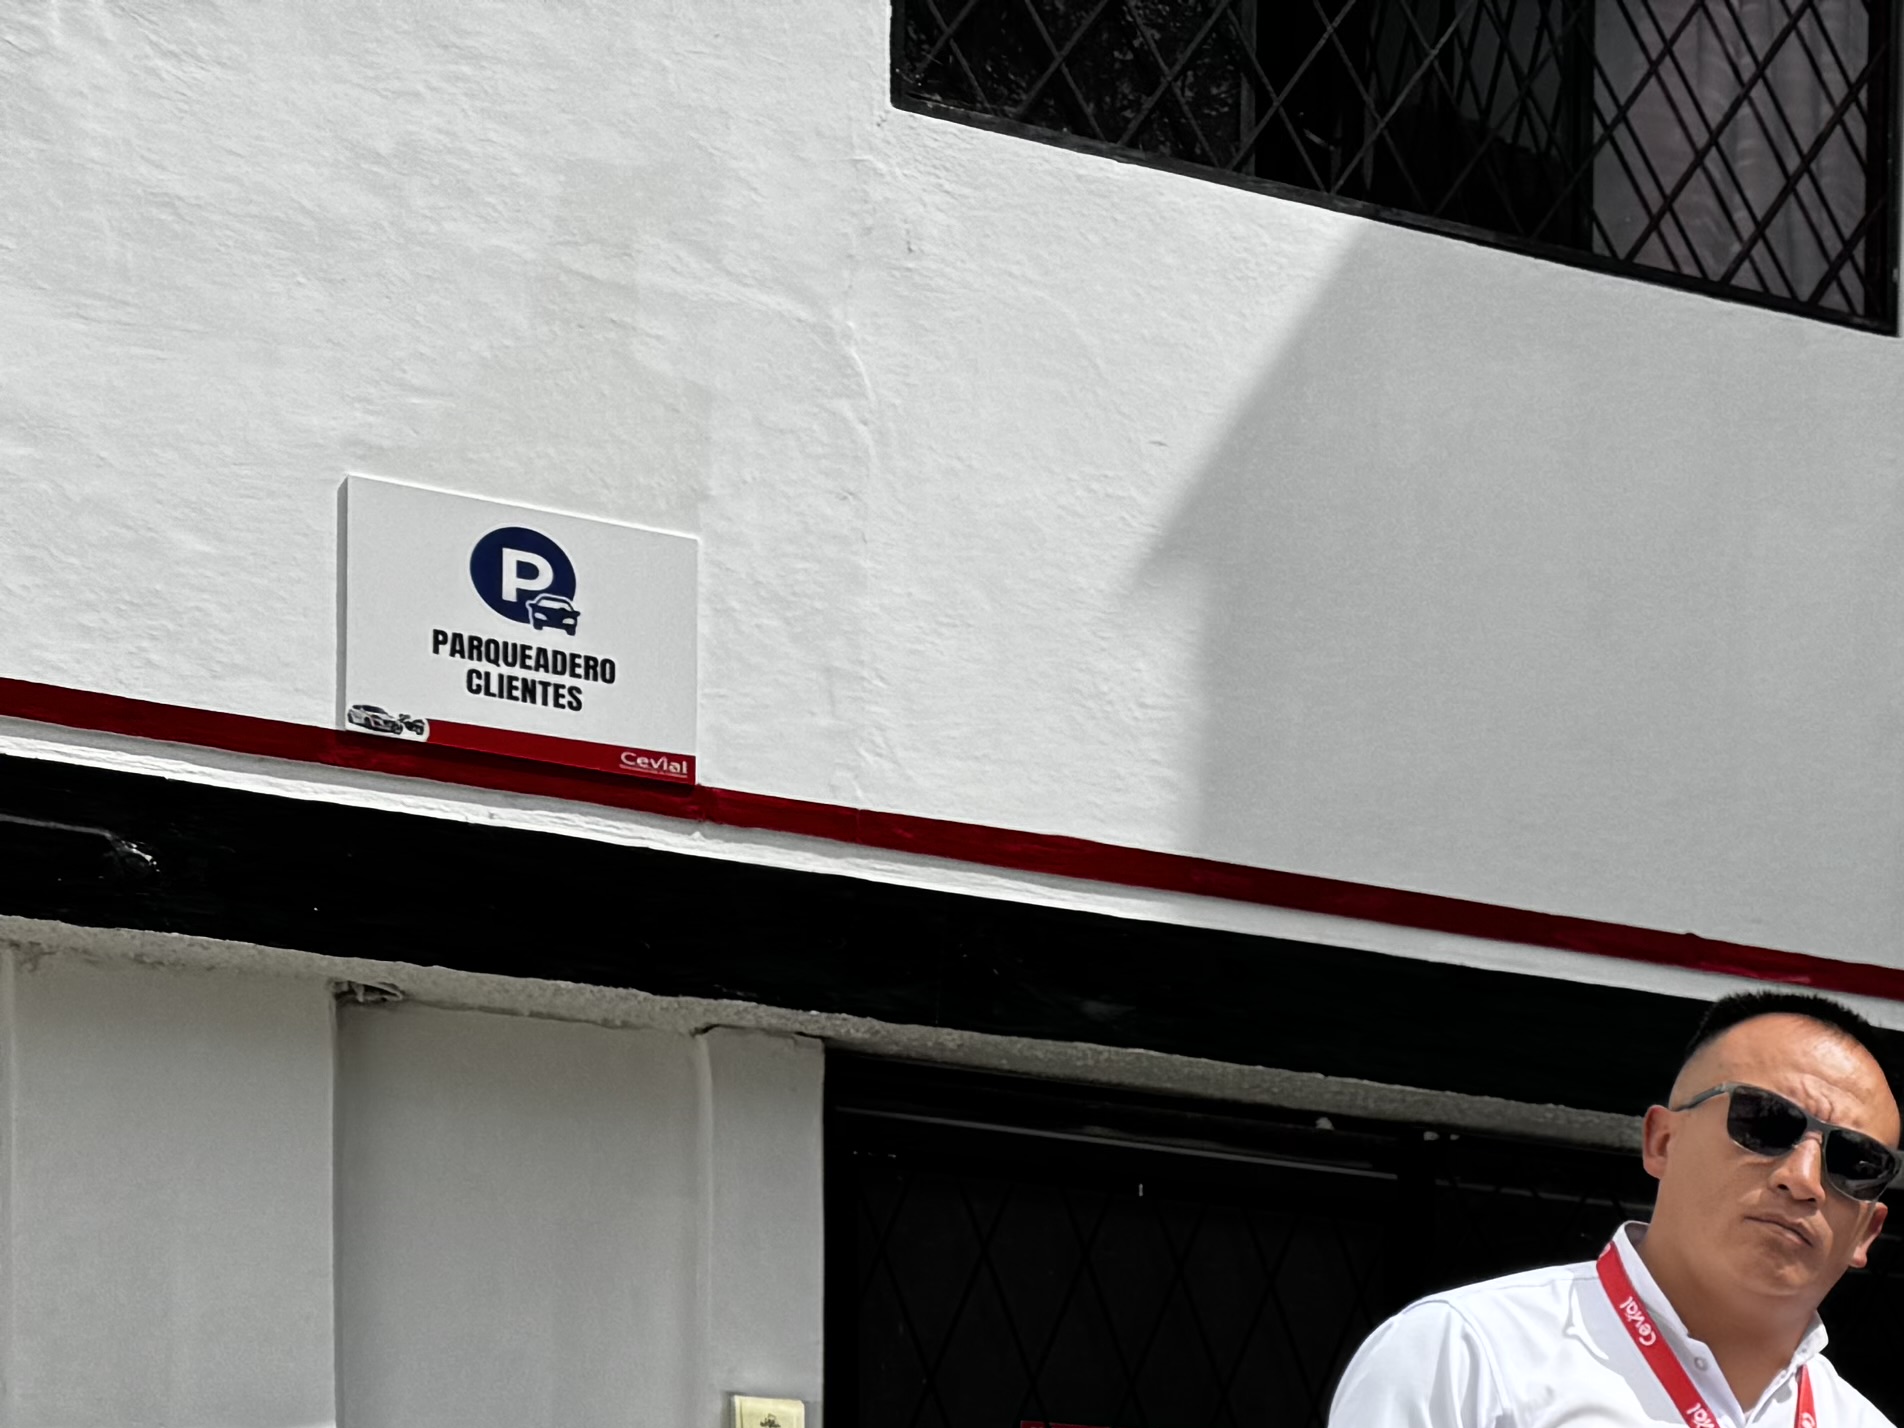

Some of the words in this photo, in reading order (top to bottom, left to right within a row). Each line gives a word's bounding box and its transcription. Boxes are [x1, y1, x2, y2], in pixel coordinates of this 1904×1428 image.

[501, 547, 554, 602] P
[432, 629, 616, 684] PARQUEADERO
[466, 668, 583, 711] CLIENTES
[1619, 1296, 1656, 1346] Cevial
